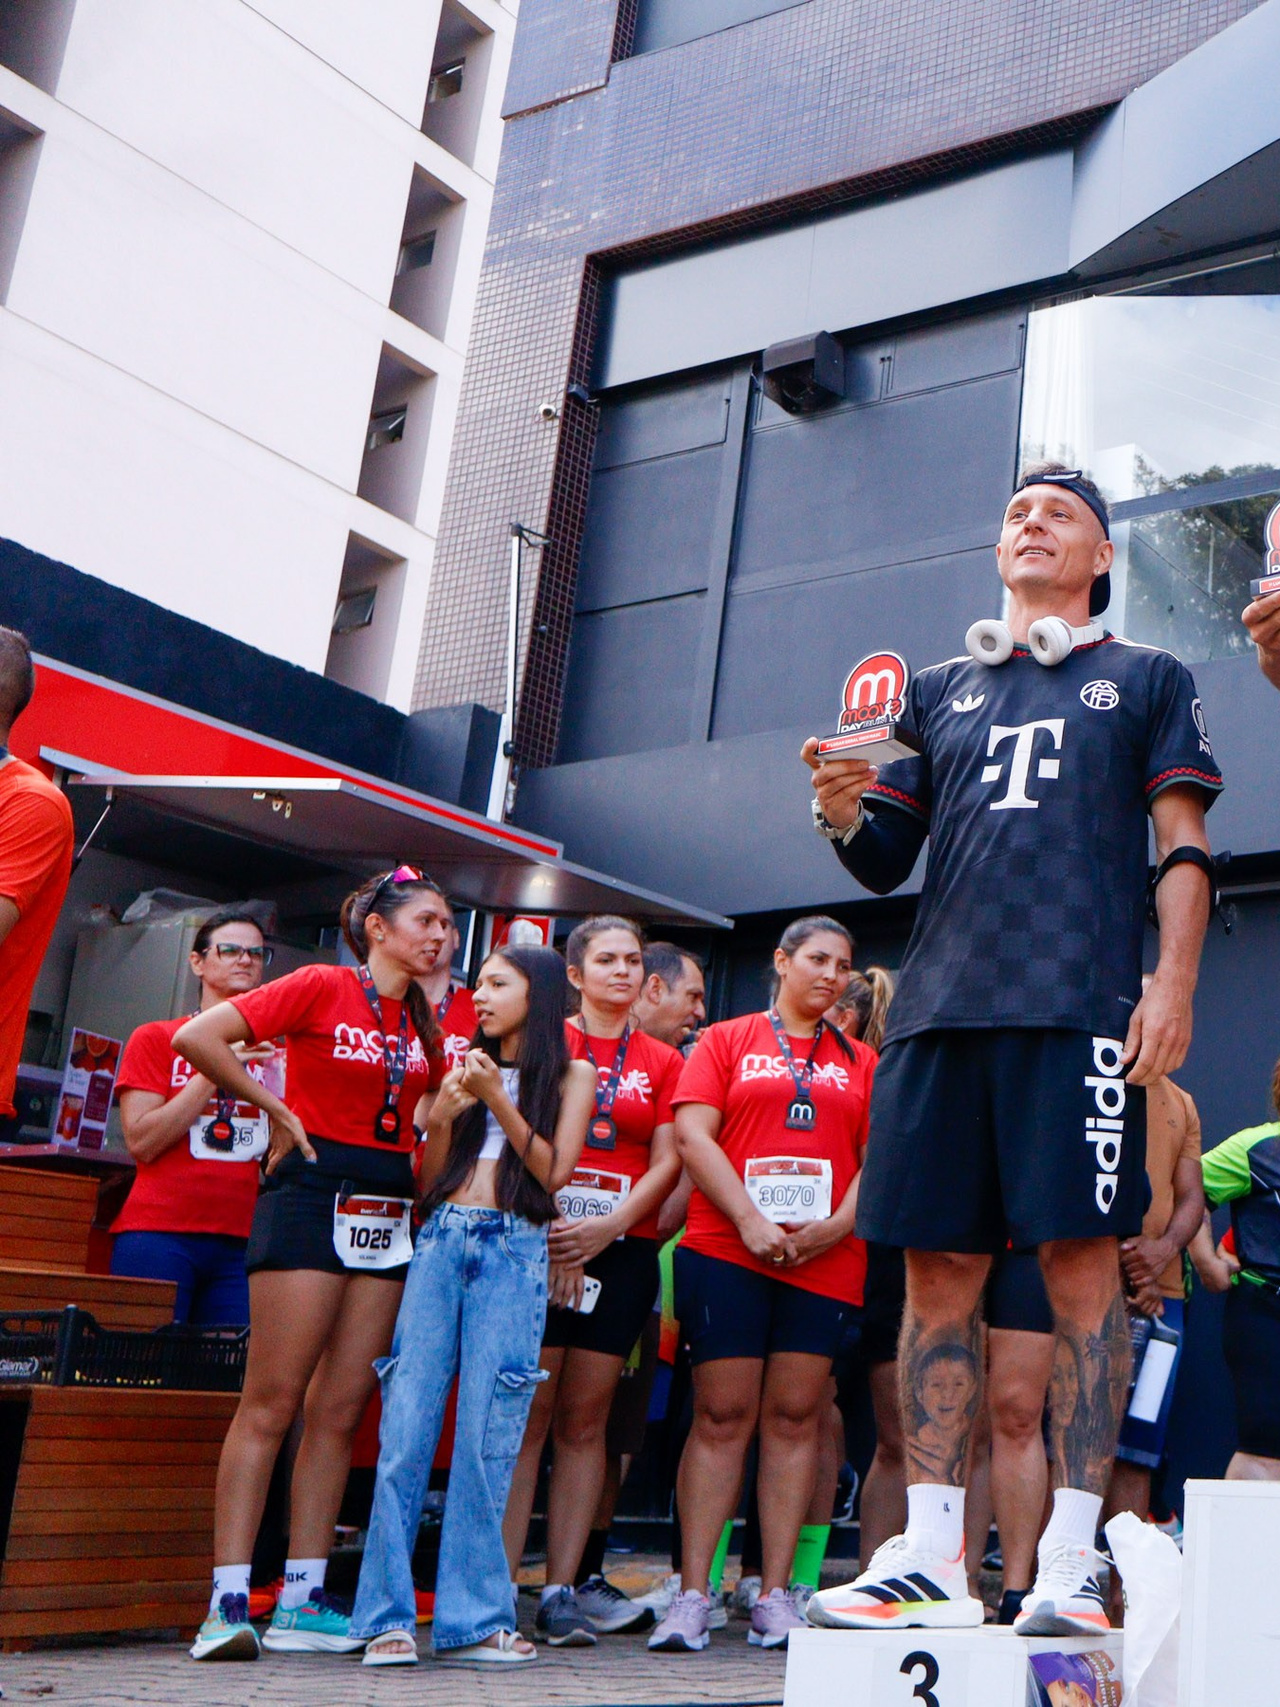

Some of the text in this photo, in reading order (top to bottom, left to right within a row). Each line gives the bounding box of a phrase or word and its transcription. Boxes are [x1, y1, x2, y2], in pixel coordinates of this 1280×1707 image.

[759, 1185, 815, 1207] 3070
[350, 1226, 393, 1250] 1025
[899, 1650, 941, 1707] 3
